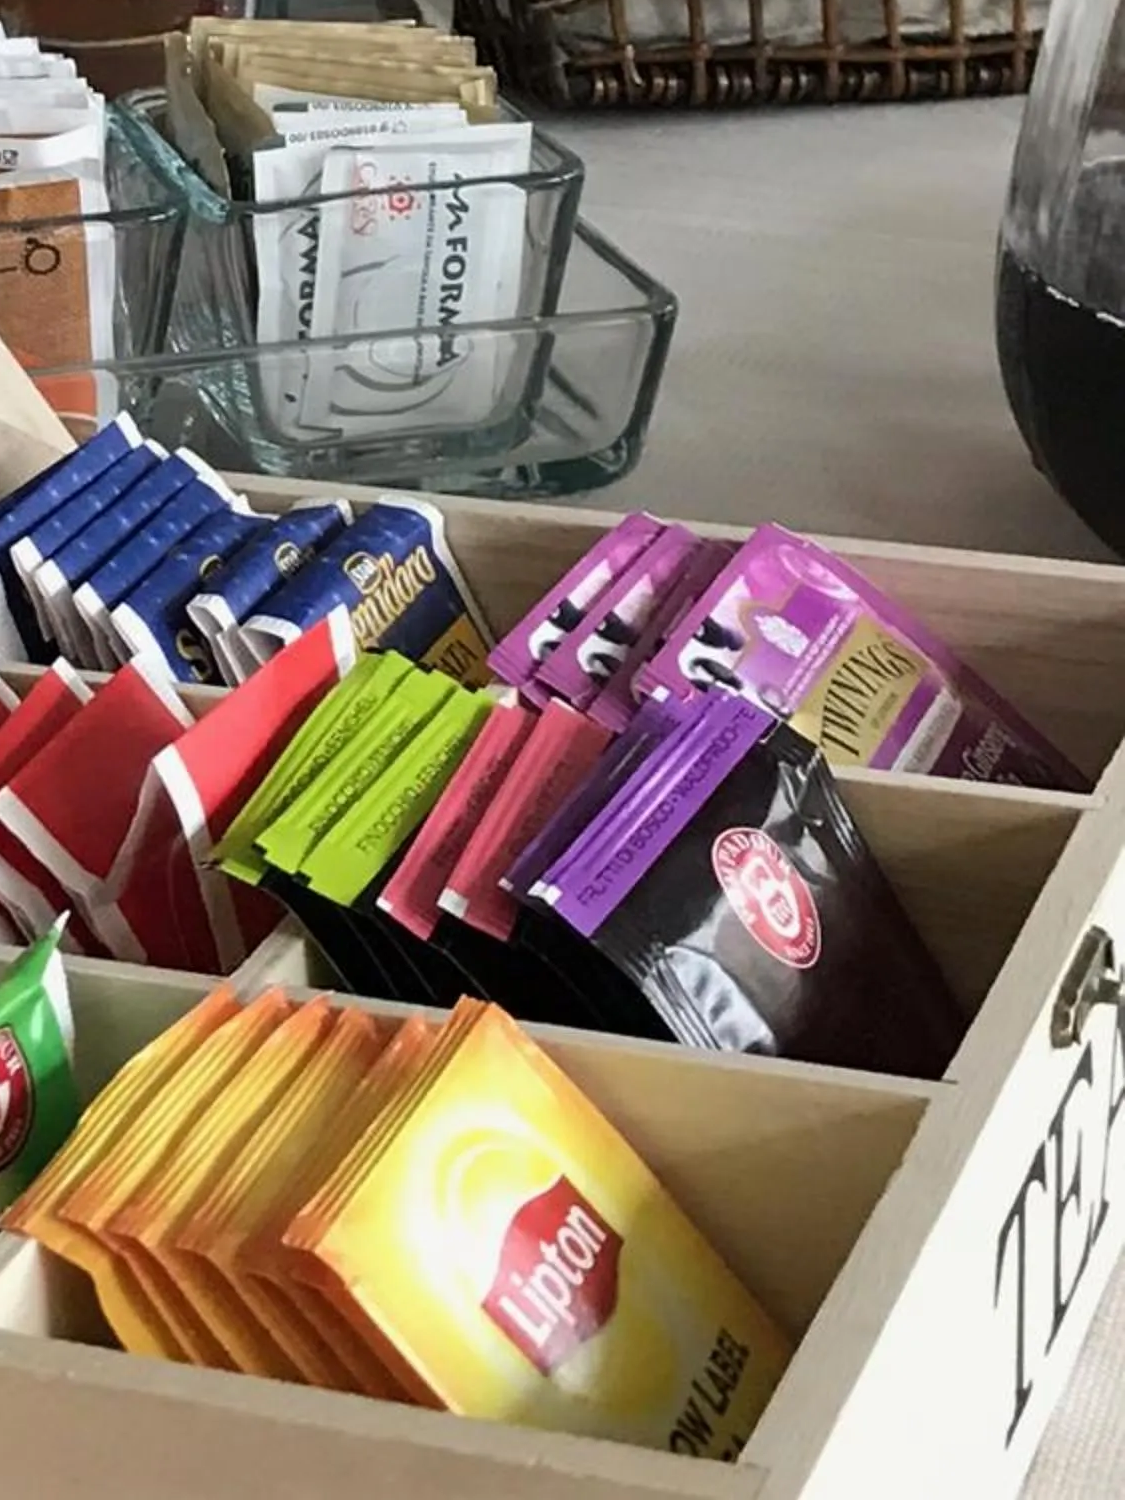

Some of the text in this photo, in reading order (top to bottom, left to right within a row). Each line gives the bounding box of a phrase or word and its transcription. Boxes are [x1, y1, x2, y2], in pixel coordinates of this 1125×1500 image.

[298, 213, 321, 338] ORMA
[820, 641, 915, 756] TWININGS
[575, 857, 627, 910] FRUTTI
[626, 799, 677, 851] BOSCO
[499, 1204, 607, 1349] Lipton
[692, 1327, 751, 1416] LABEL
